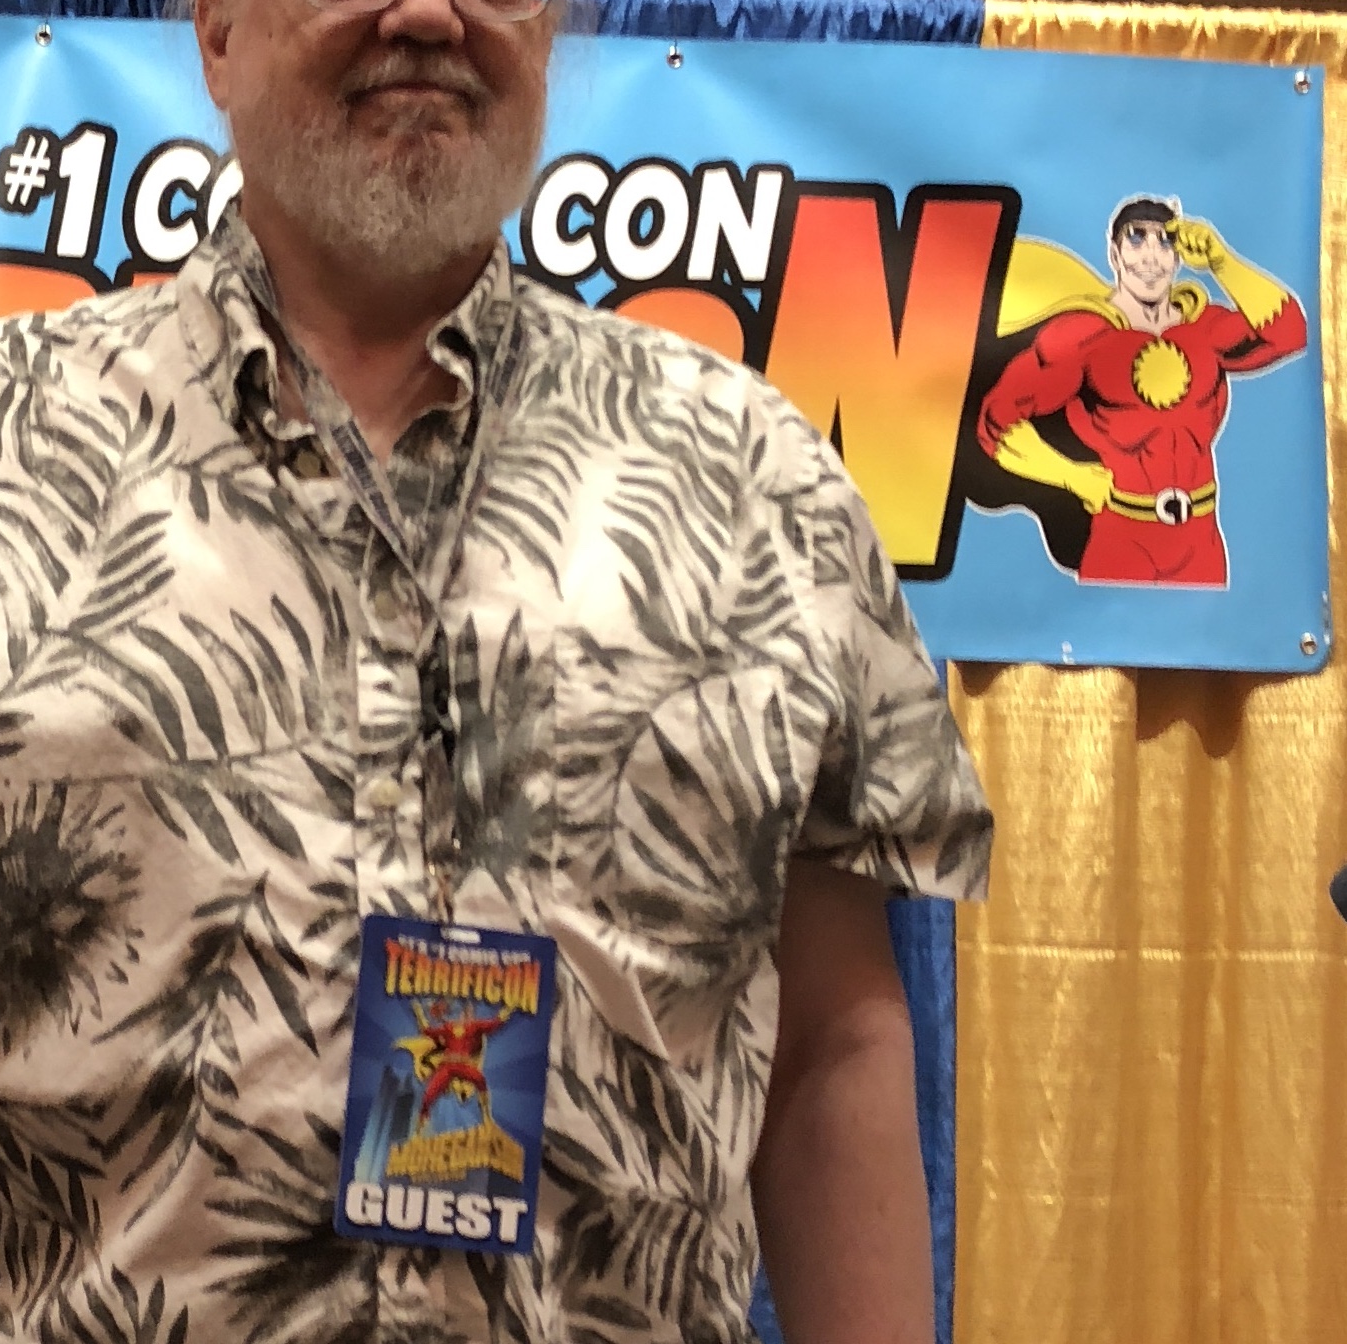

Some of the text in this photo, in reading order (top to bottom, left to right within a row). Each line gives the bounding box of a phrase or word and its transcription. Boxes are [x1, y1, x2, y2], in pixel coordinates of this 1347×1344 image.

[4, 129, 108, 257] #1
[530, 159, 784, 282] CON
[344, 1179, 529, 1244] GUEST
